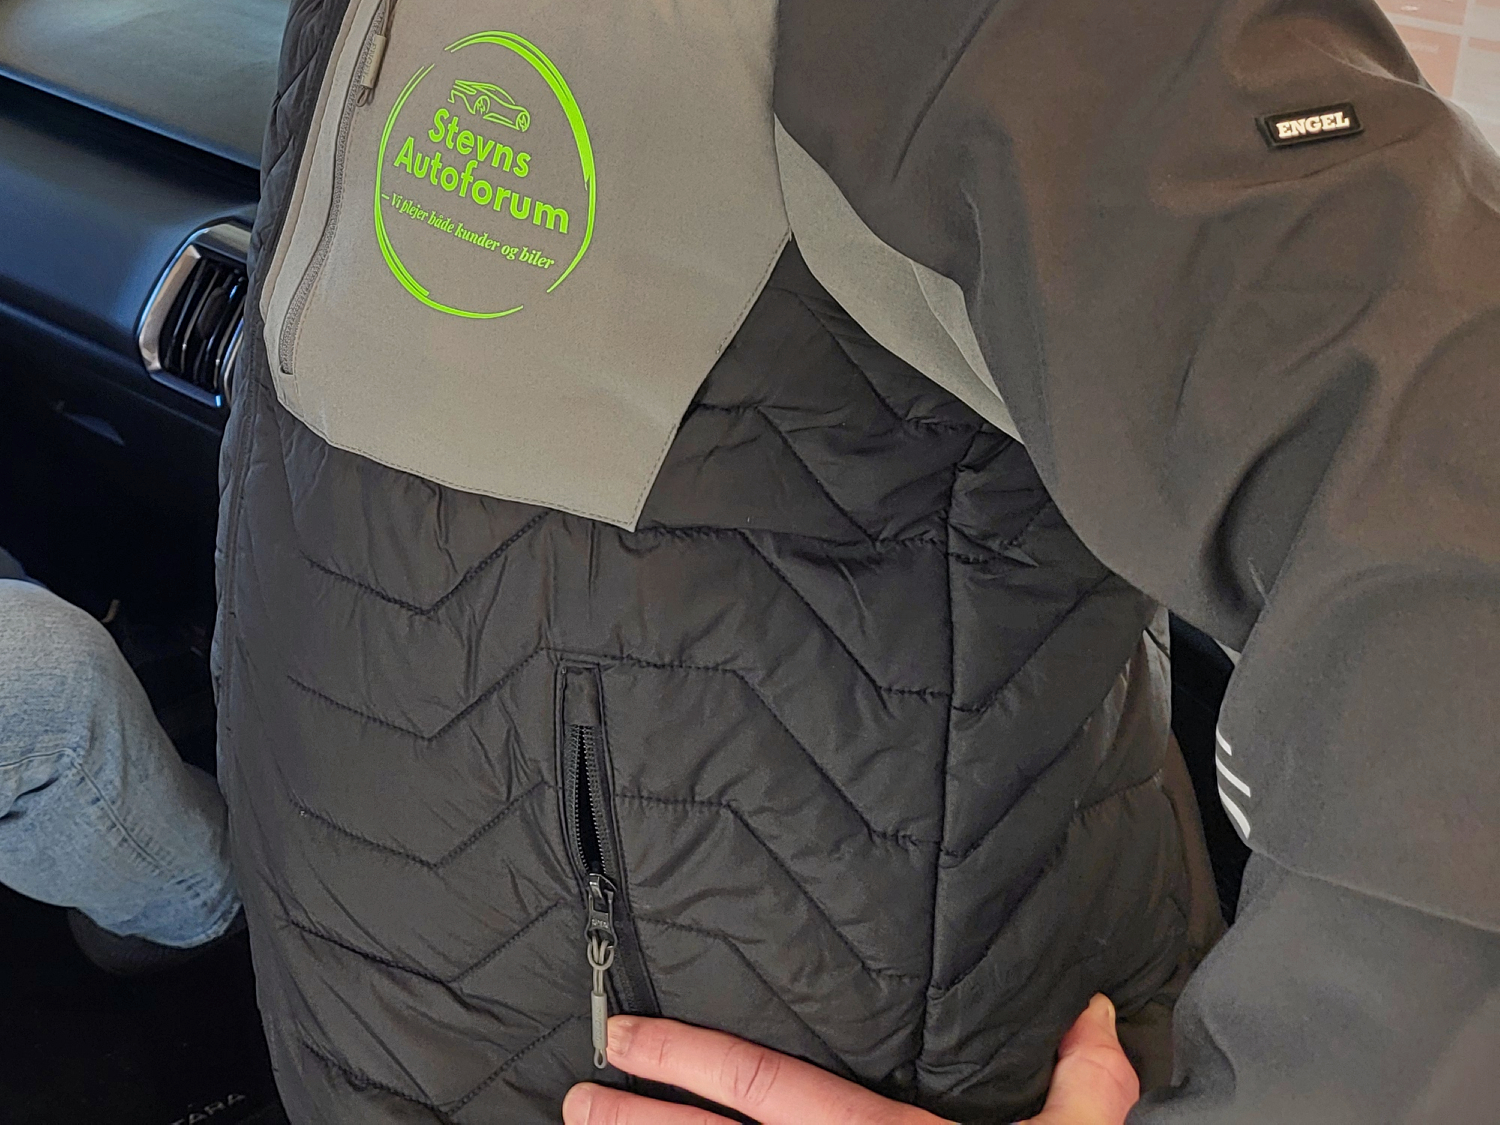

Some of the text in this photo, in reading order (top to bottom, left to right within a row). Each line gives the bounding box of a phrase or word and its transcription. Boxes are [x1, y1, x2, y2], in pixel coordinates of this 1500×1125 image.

[428, 108, 531, 178] Stevns
[1276, 112, 1350, 139] ENGEL
[393, 136, 569, 234] Autoforum
[398, 199, 429, 221] plejer
[427, 210, 455, 233] både
[453, 222, 500, 251] kunder
[500, 244, 519, 261] og
[518, 246, 555, 269] biler
